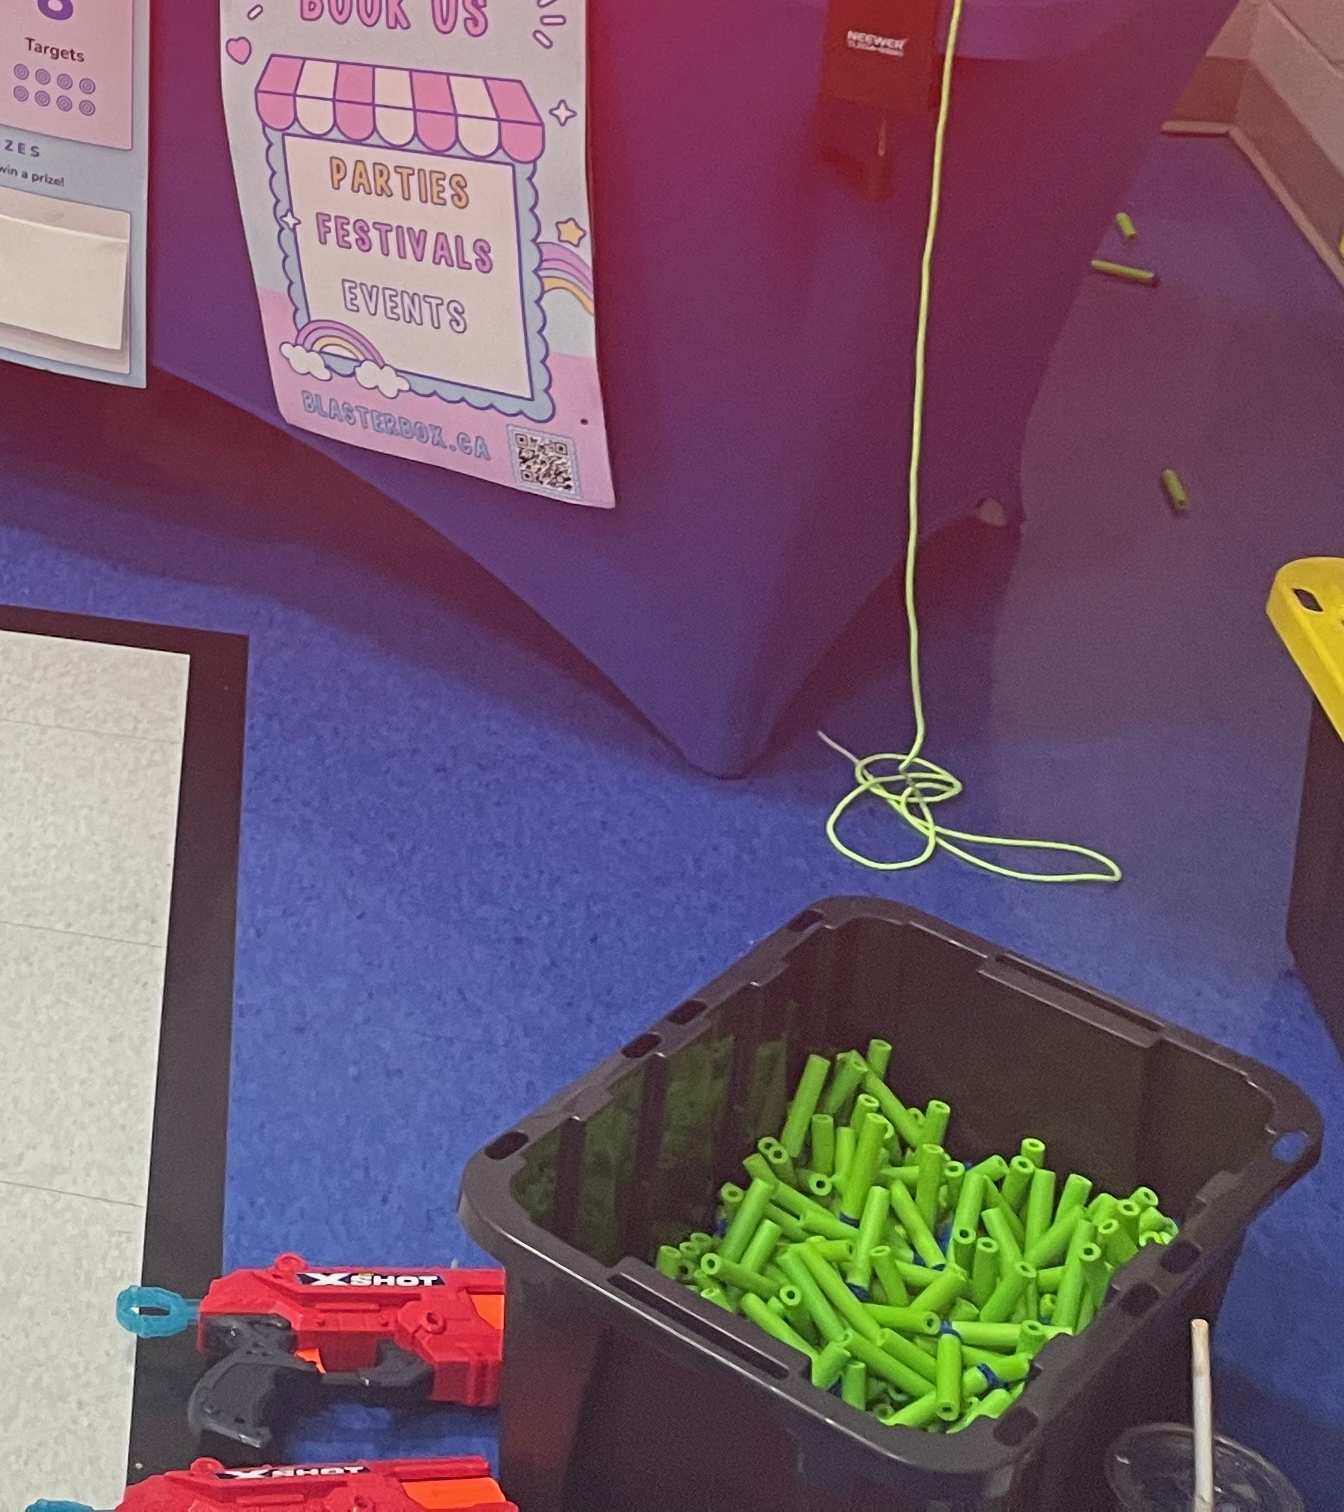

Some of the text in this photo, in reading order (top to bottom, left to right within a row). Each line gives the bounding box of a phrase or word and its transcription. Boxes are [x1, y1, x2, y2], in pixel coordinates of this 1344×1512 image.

[24, 36, 85, 63] Targets
[21, 170, 29, 179] a
[31, 172, 65, 187] prize!
[329, 155, 470, 209] PARTIES
[314, 211, 495, 275] FESTIVALS
[339, 278, 469, 334] EVENTS
[301, 389, 492, 461] BLASTERBOX.CA
